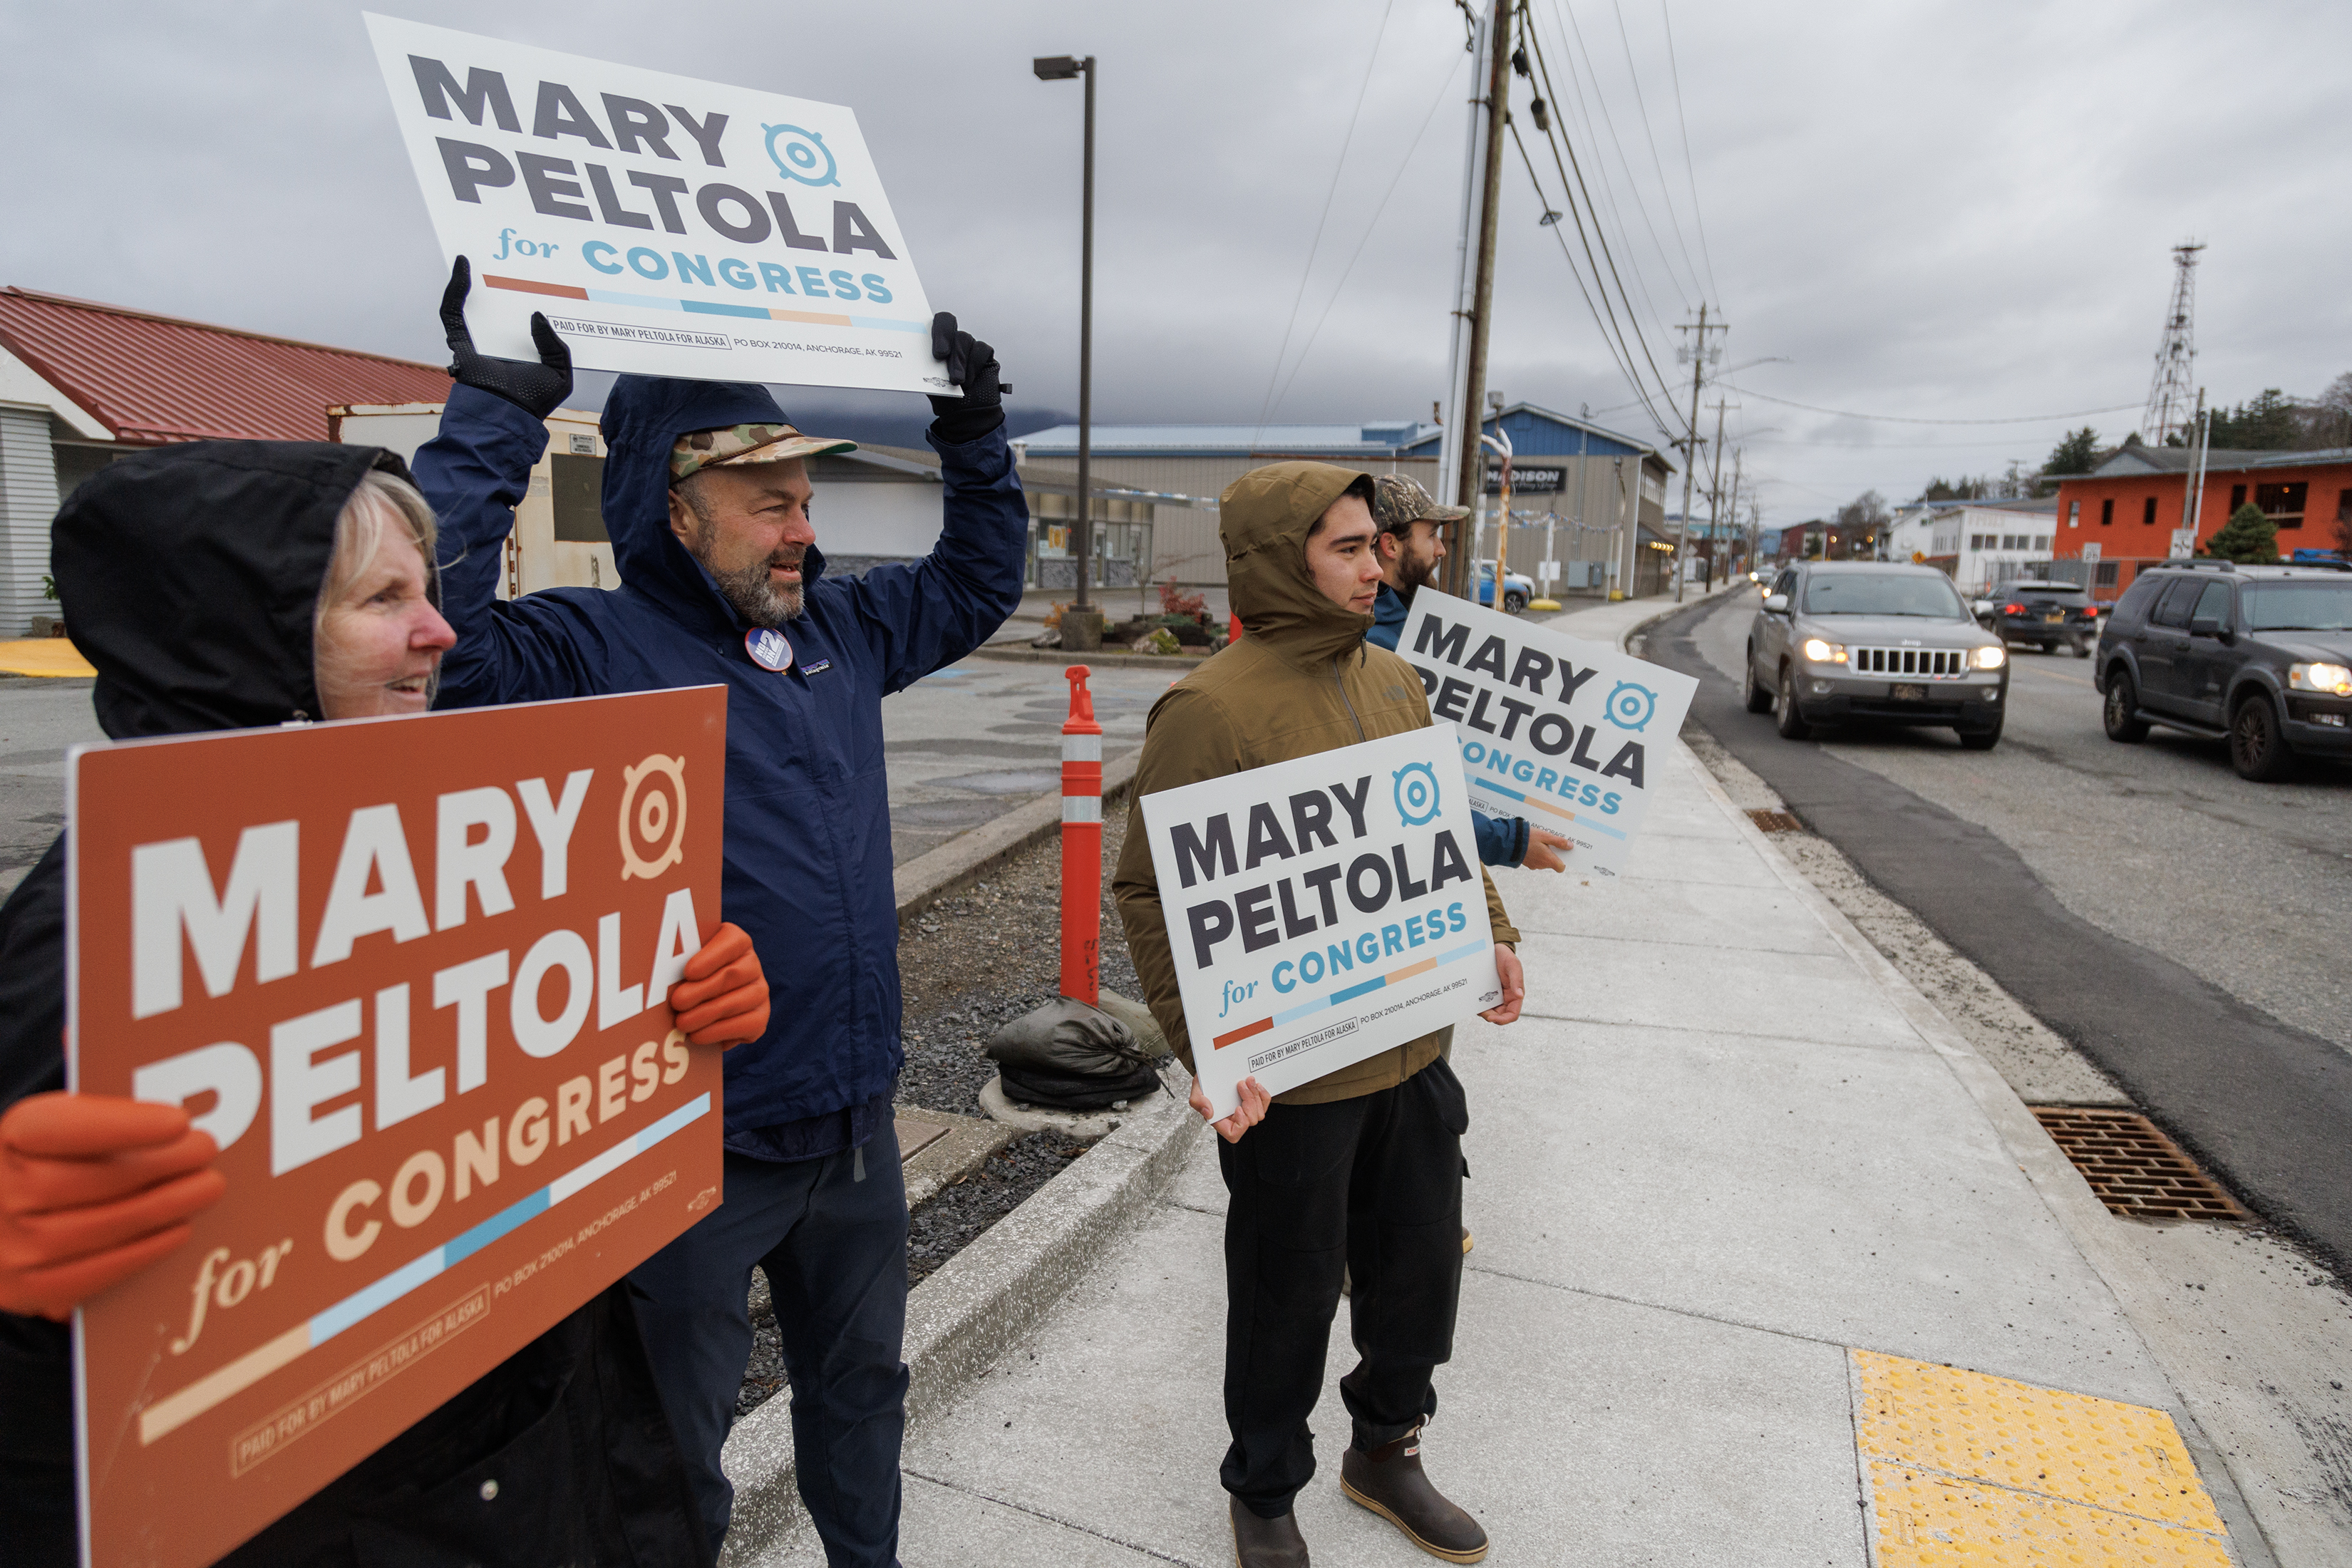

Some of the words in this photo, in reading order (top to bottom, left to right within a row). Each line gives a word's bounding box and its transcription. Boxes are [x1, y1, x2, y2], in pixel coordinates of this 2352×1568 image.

[407, 53, 730, 168] MARY
[435, 136, 898, 260] PELTOLA
[492, 227, 559, 261] for
[582, 240, 894, 304] CONGRESS
[552, 320, 575, 331] PAID
[577, 322, 596, 334] FOR
[597, 325, 609, 335] BY
[611, 326, 637, 338] MARY
[639, 329, 675, 342] PELTOLA
[676, 334, 693, 344] FOR
[695, 335, 727, 346] ALASKA
[733, 339, 748, 347] PO
[750, 339, 771, 349] BOX
[772, 341, 805, 351] 210014,
[806, 344, 864, 356] ANCHORAGE,
[877, 350, 903, 359] 99521
[755, 641, 766, 657] NO
[760, 630, 782, 654] 2
[765, 648, 777, 664] ON
[1413, 613, 1599, 706] MARY
[1457, 735, 1623, 815] ONGRESS
[1498, 810, 1512, 819] BOX
[1170, 775, 1373, 889] MARY
[1576, 840, 1593, 850] 99521
[132, 768, 595, 1021] MARY
[1186, 829, 1474, 969] PELTOLA
[1218, 978, 1259, 1018] for
[1272, 902, 1467, 994] CONGRESS
[1360, 1016, 1370, 1025] PO
[1370, 1011, 1384, 1021] BOX
[1384, 1003, 1405, 1016] 210014,
[1405, 988, 1443, 1008] ANCHORAGE,
[1443, 984, 1452, 993] AK
[1451, 978, 1468, 990] 99521
[132, 887, 703, 1177] PELTOLA
[1251, 1057, 1264, 1068] PAID
[1265, 1052, 1276, 1063] FOR
[1276, 1048, 1285, 1058] BY
[1285, 1041, 1301, 1056] MARY
[1301, 1033, 1325, 1049] PELTOLA
[1324, 1028, 1336, 1040] FOR
[1336, 1021, 1356, 1035] ALASKA
[171, 1237, 294, 1356] for
[323, 1028, 691, 1262] CONGRESS
[494, 1276, 512, 1299] PO
[513, 1260, 539, 1287] BOX
[540, 1237, 577, 1270] 210014,
[577, 1196, 639, 1244] ANCHORAGE,
[639, 1187, 652, 1205] AK
[652, 1170, 677, 1196] 99521
[239, 1425, 277, 1460] PAID
[277, 1404, 306, 1440] FOR
[308, 1395, 328, 1420] BY
[329, 1371, 367, 1405] MARY
[367, 1336, 421, 1382] PELTOLA
[419, 1319, 443, 1348] FOR
[443, 1293, 485, 1334] ALASKA
